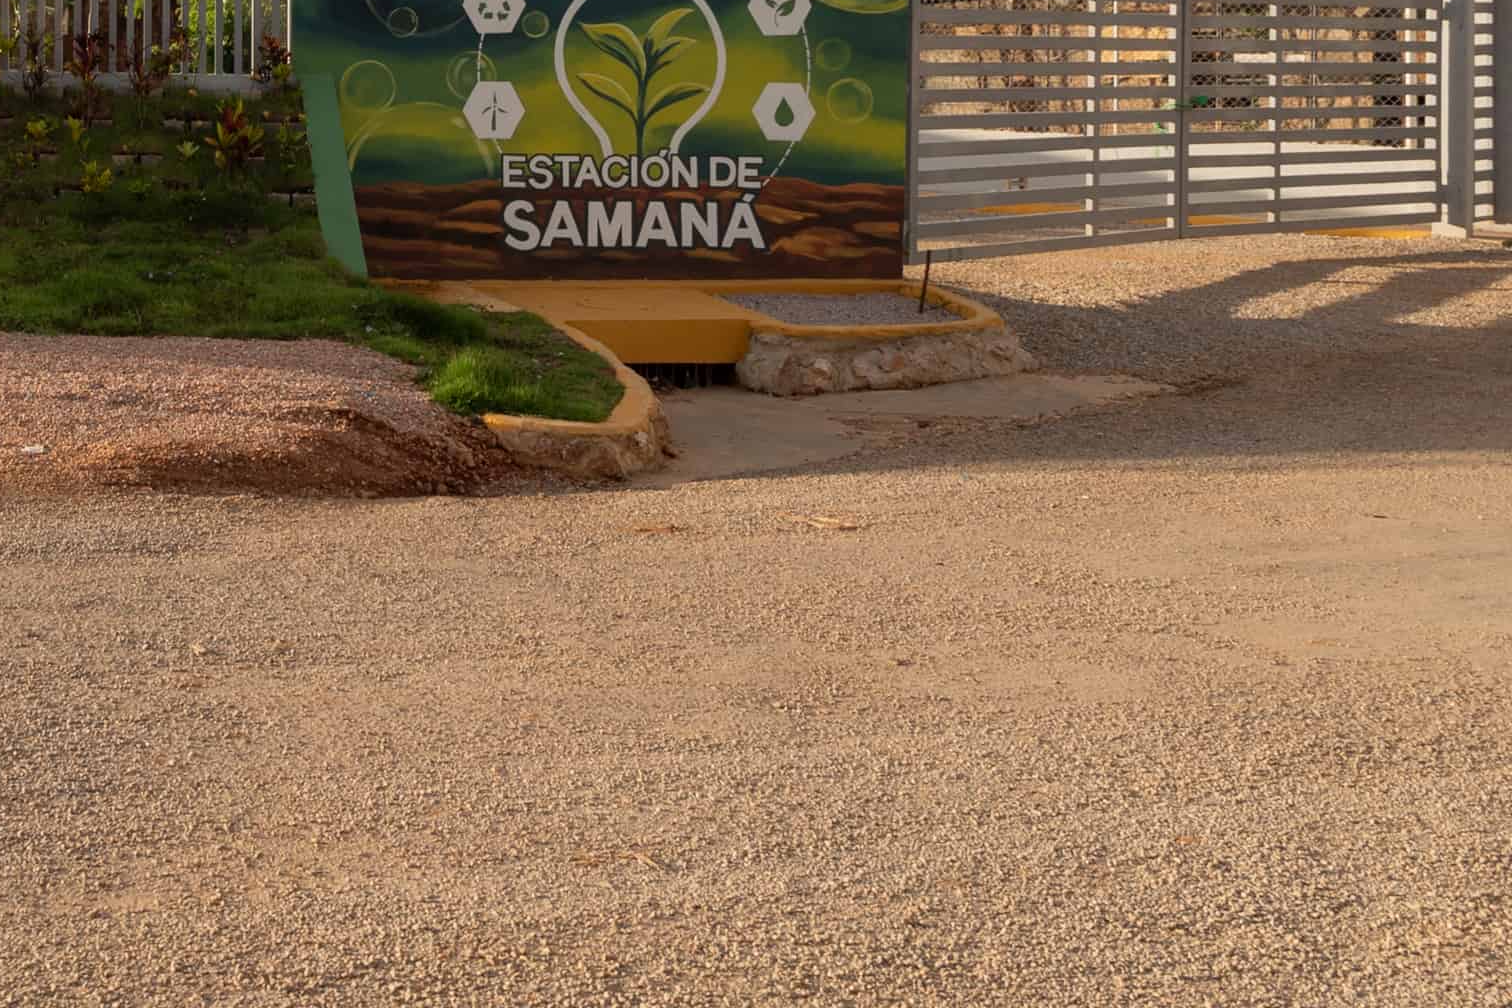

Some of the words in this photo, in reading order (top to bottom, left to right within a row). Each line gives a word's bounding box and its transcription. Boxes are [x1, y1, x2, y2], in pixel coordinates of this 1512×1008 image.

[501, 149, 699, 189] ESTACIÓN
[708, 156, 764, 189] DE
[502, 193, 766, 252] SAMANÁ
